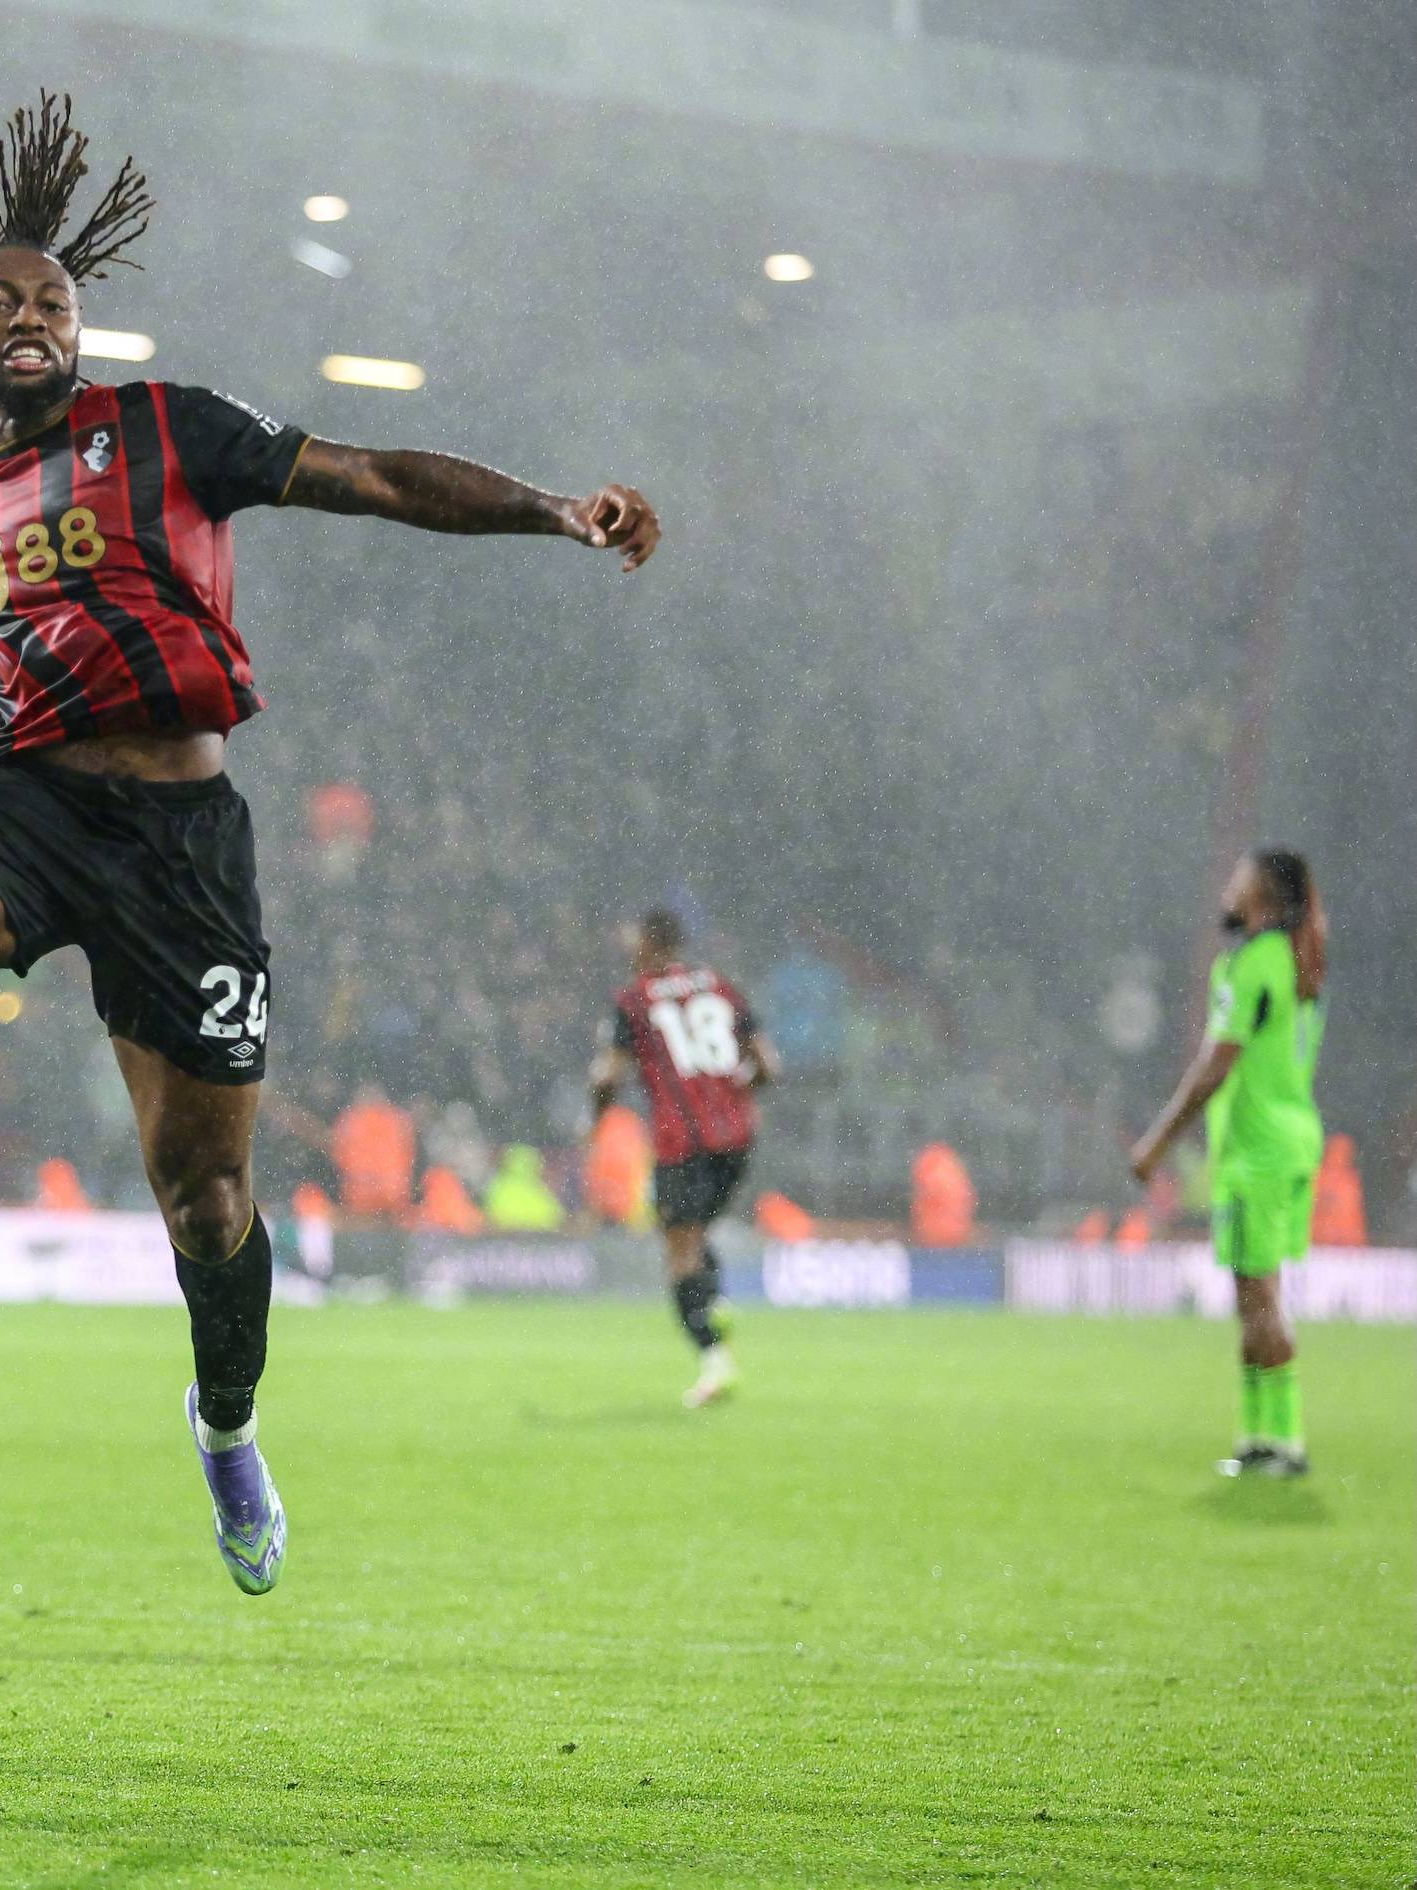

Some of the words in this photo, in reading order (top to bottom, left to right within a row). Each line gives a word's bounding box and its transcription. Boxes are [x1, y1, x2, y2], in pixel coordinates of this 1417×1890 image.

[199, 965, 268, 1045] 24
[648, 993, 740, 1079] 18
[229, 1059, 254, 1068] umbro
